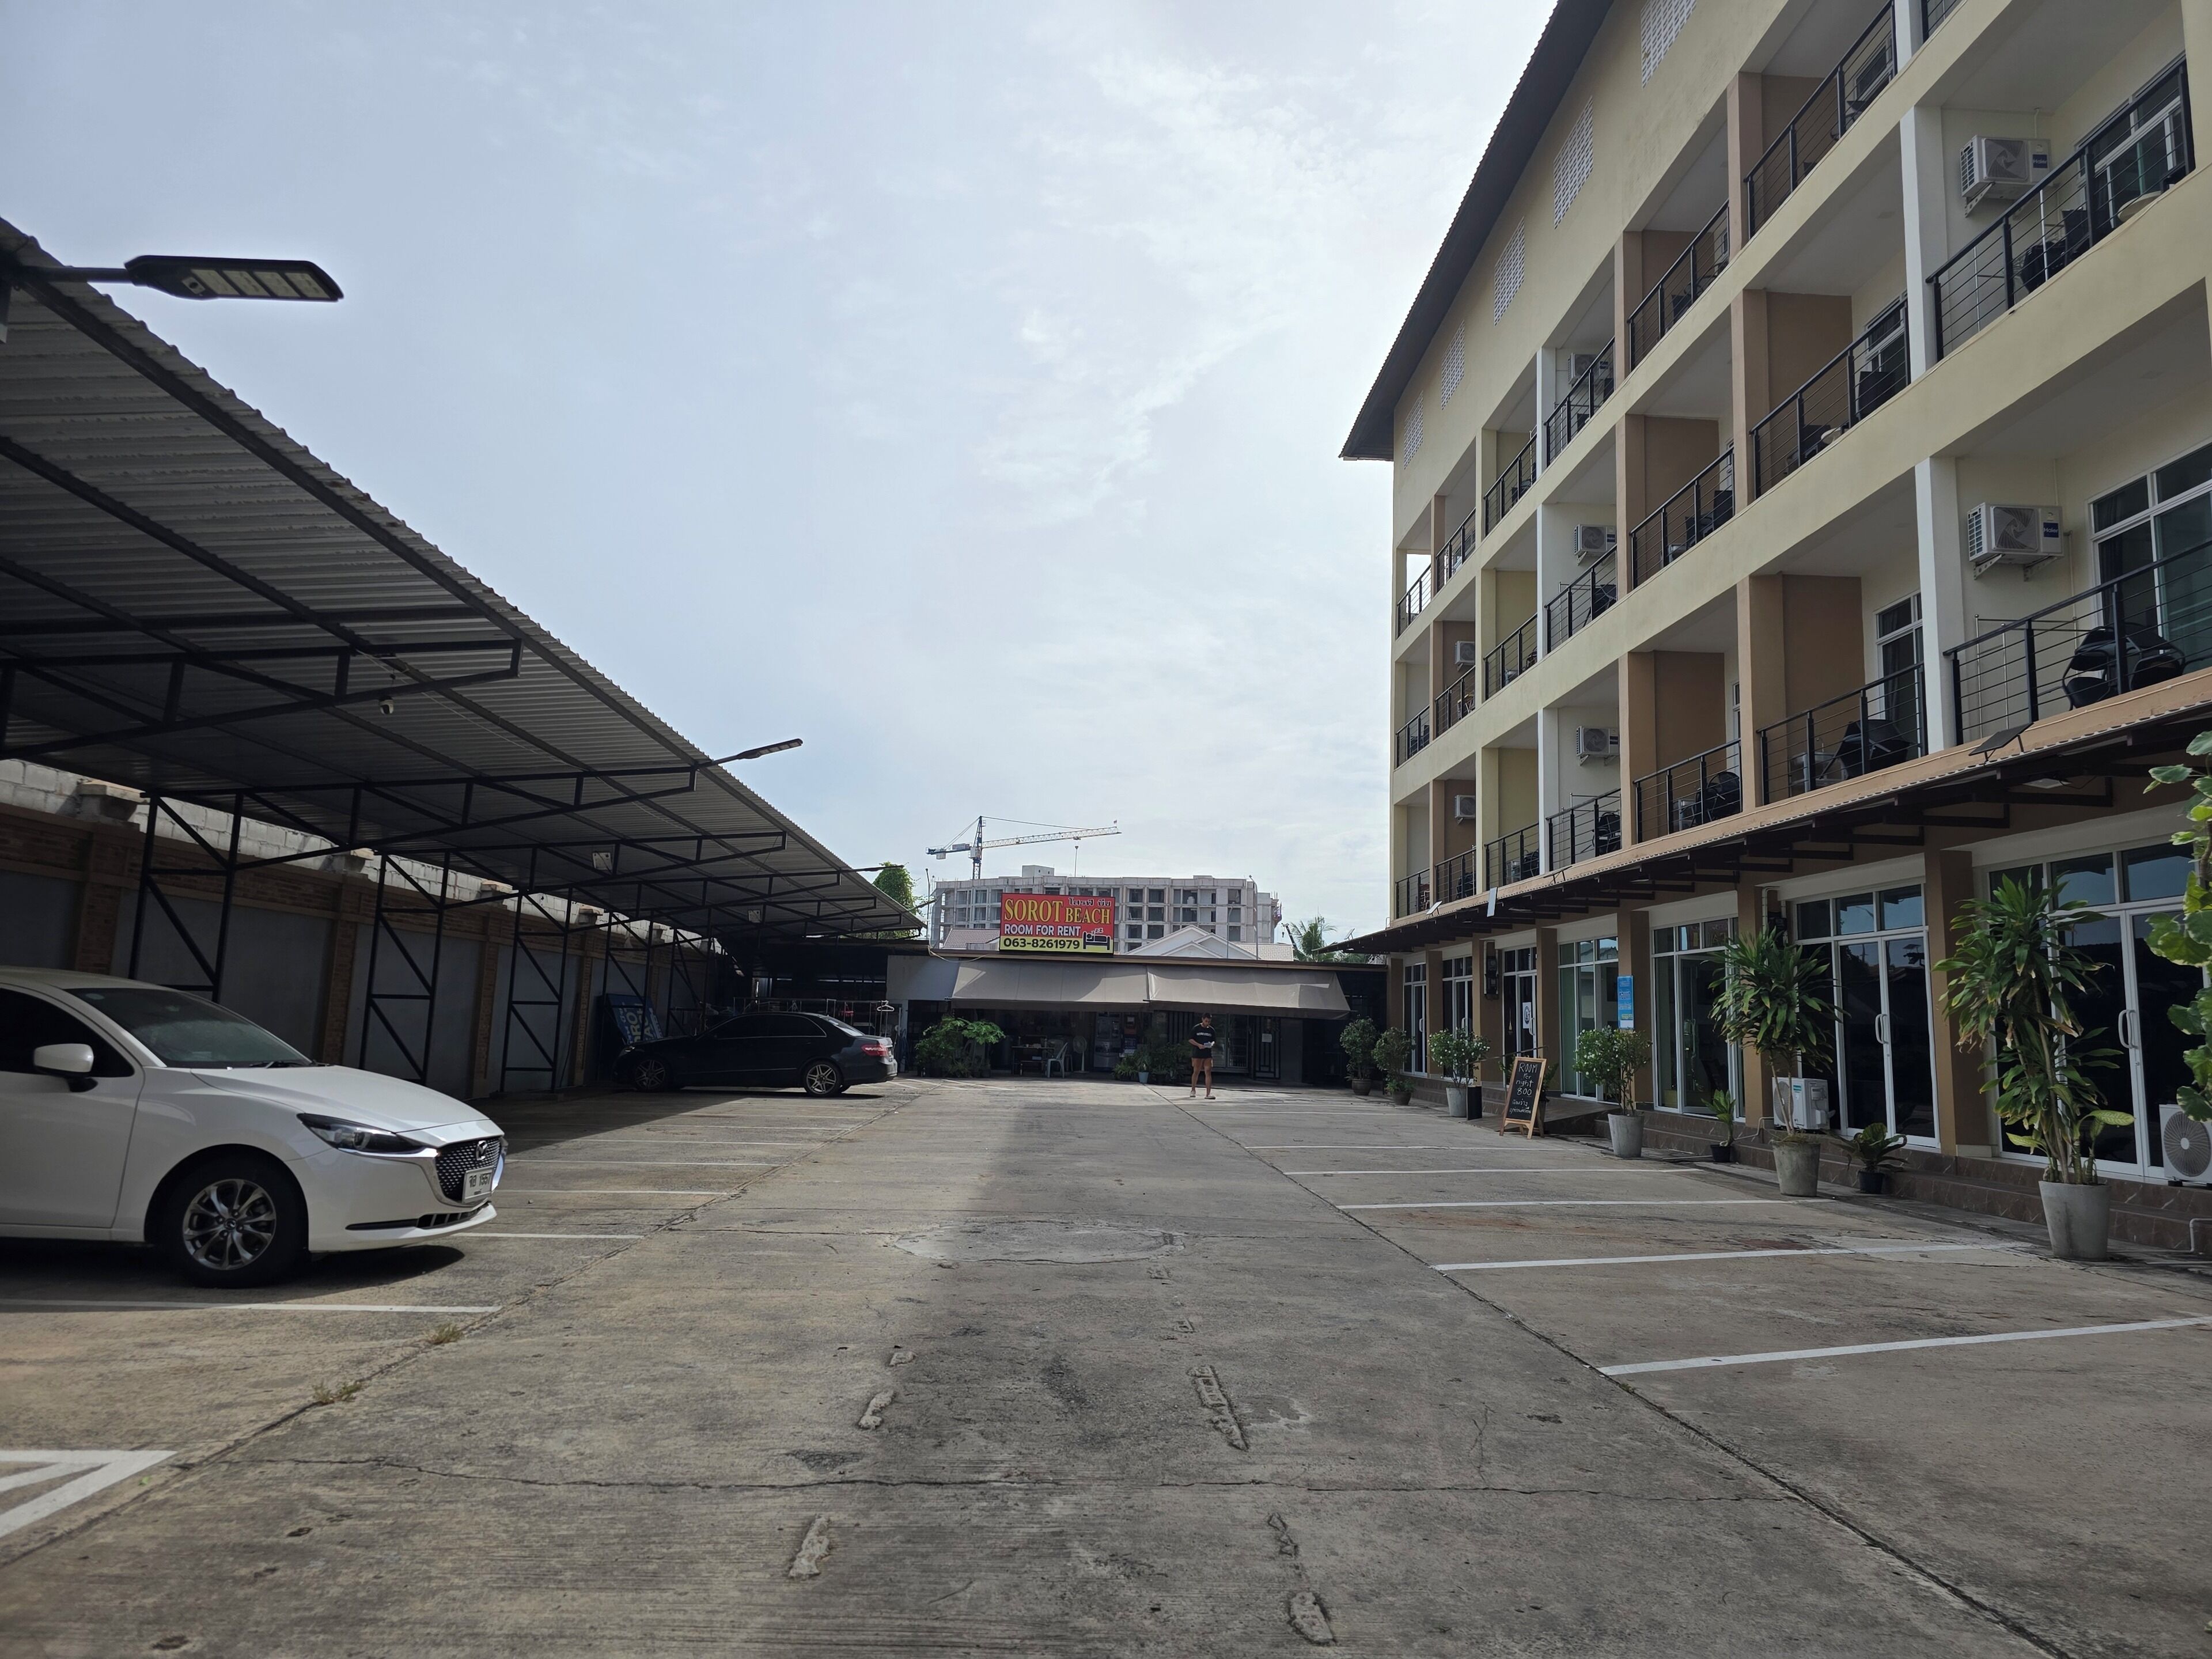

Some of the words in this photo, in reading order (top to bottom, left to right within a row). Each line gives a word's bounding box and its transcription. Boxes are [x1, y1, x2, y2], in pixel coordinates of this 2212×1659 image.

[1004, 899, 1063, 922] SOROT
[1065, 907, 1111, 924] BEACH
[1004, 924, 1033, 935] ROOM
[1036, 925, 1055, 936] FOR
[1057, 926, 1081, 937] RENT
[1003, 938, 1080, 949] 063-8261979
[1518, 1062, 1538, 1073] ROOM
[1516, 1079, 1534, 1088] night
[1517, 1088, 1532, 1096] 800
